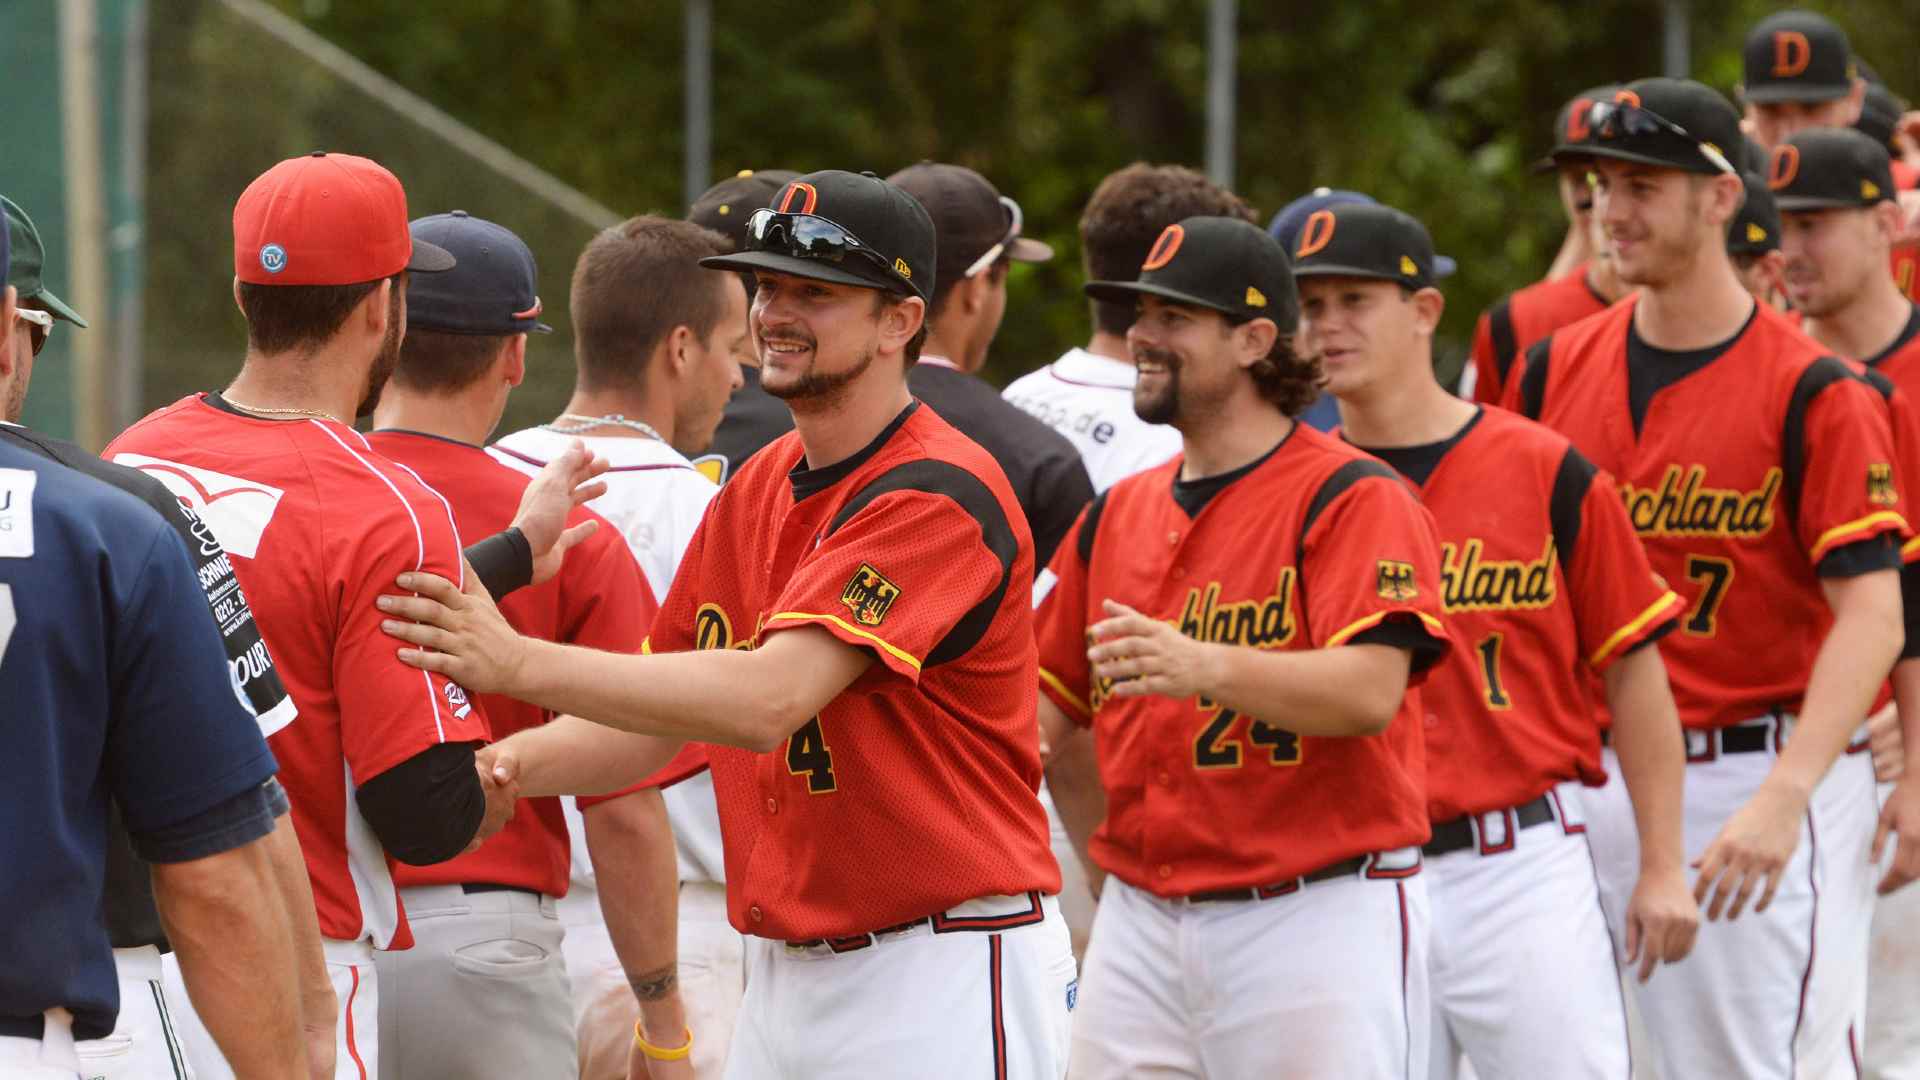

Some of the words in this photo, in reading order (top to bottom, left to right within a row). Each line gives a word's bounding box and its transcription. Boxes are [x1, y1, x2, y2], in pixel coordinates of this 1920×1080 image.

[1771, 31, 1811, 77] D
[1142, 223, 1184, 271] D
[1296, 210, 1336, 257] D
[1681, 552, 1735, 638] 7
[1477, 632, 1512, 711] 1
